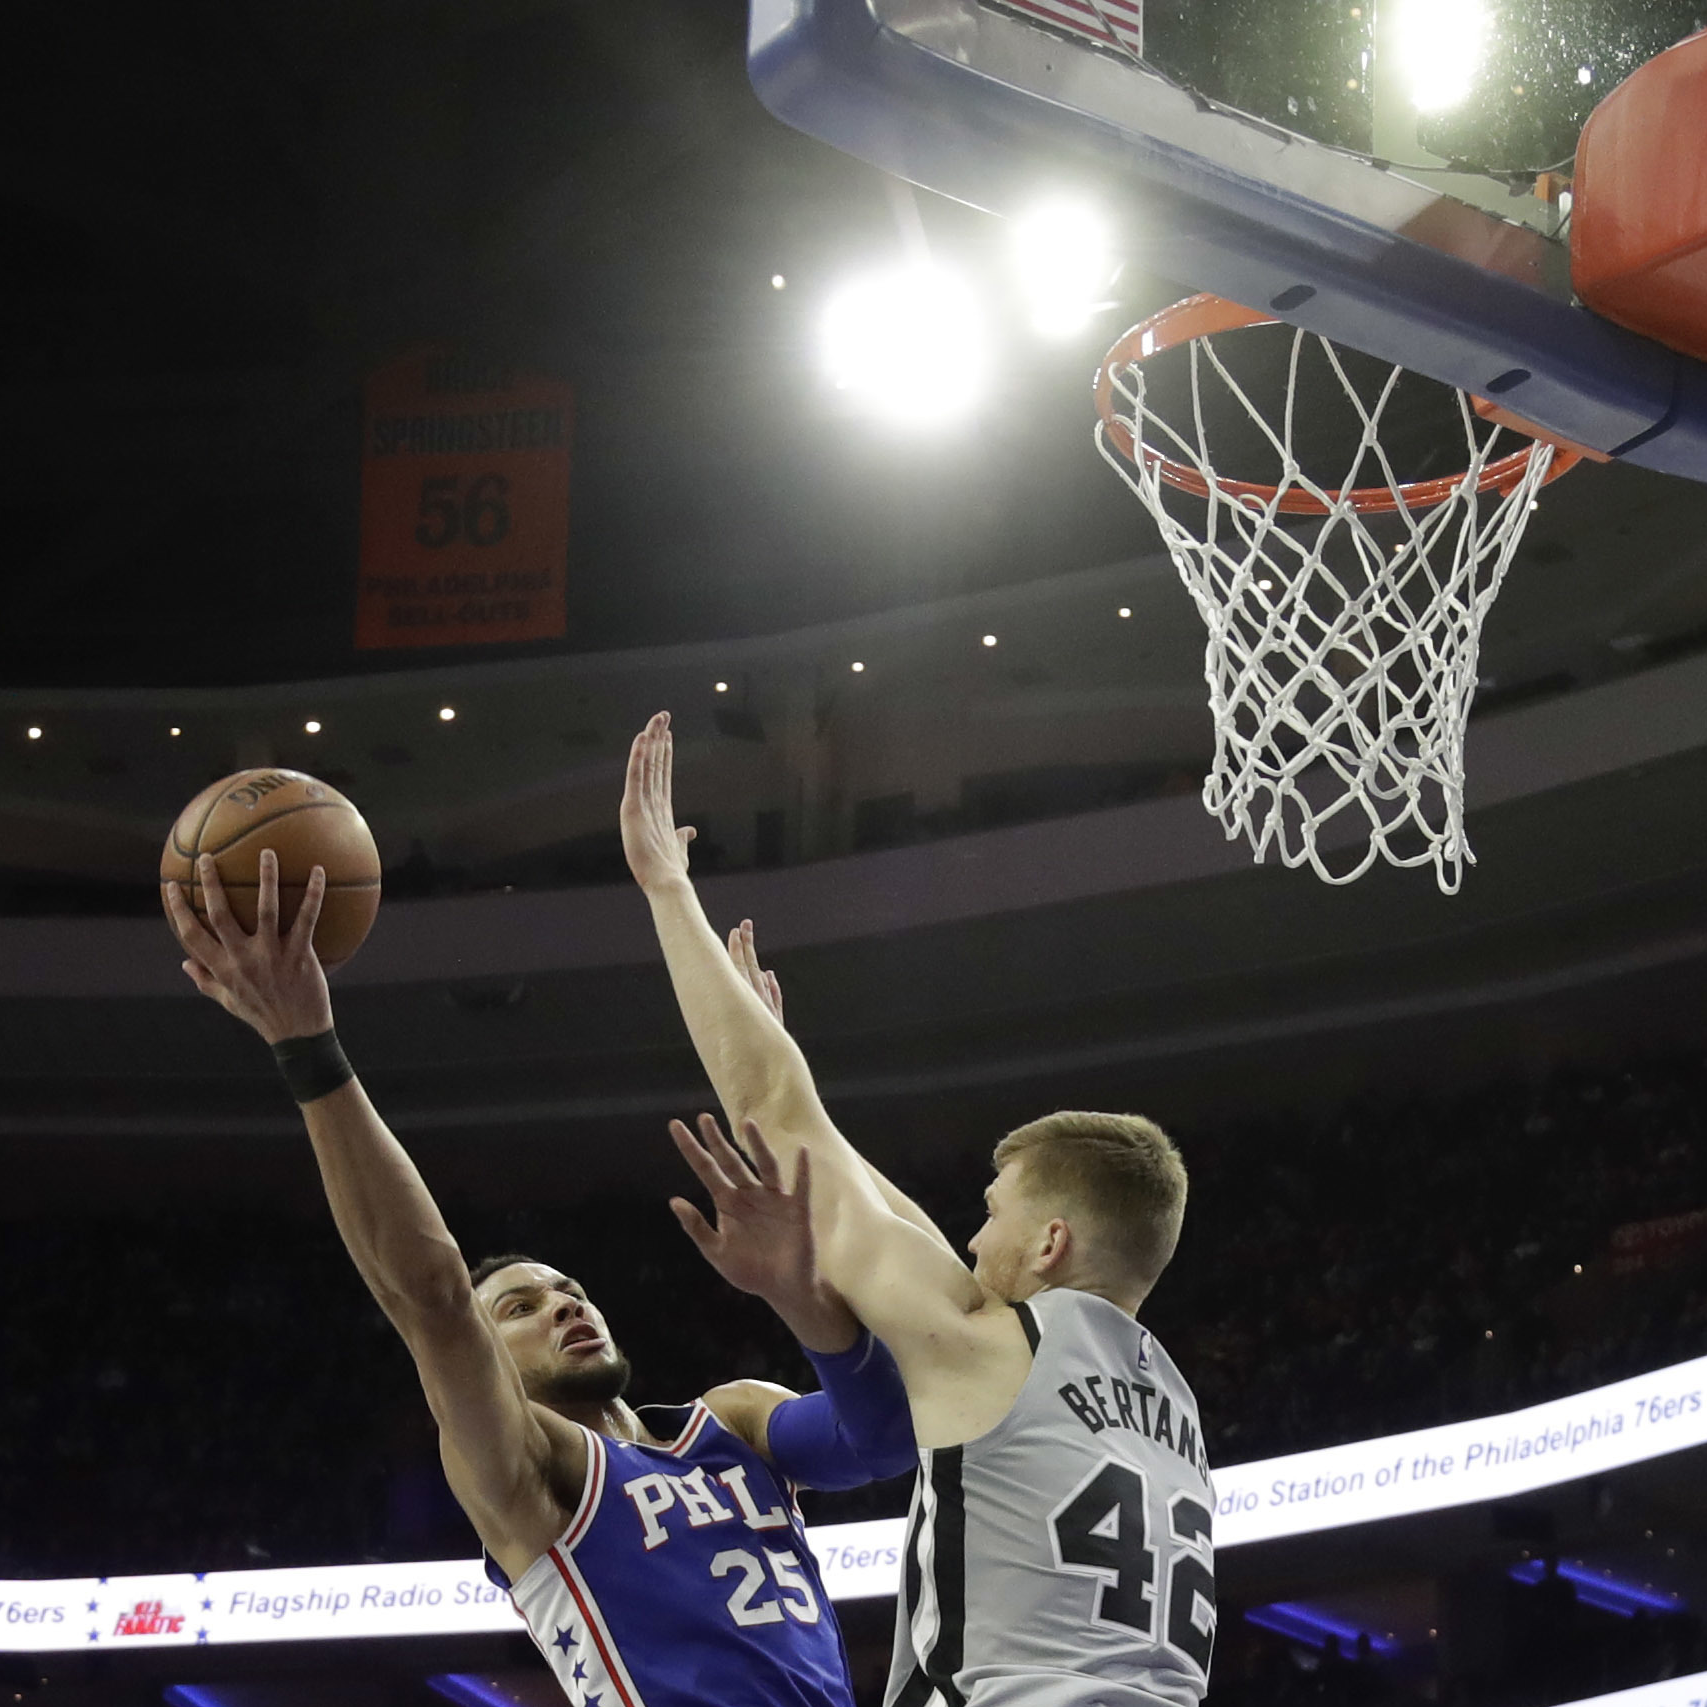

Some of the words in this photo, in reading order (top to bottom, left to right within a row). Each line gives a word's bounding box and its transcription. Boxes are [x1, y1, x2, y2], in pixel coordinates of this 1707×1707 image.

[415, 474, 510, 547] 56
[1269, 1472, 1365, 1507] Station
[1375, 1457, 1403, 1488] of
[1412, 1454, 1454, 1481] the
[1465, 1413, 1625, 1470] Philadelphia
[1636, 1390, 1702, 1425] 76ers
[709, 1546, 820, 1628] 25
[829, 1547, 898, 1568] 76ers
[1046, 1455, 1216, 1697] 42
[229, 1589, 350, 1619] Flagship
[360, 1584, 442, 1607] Radio
